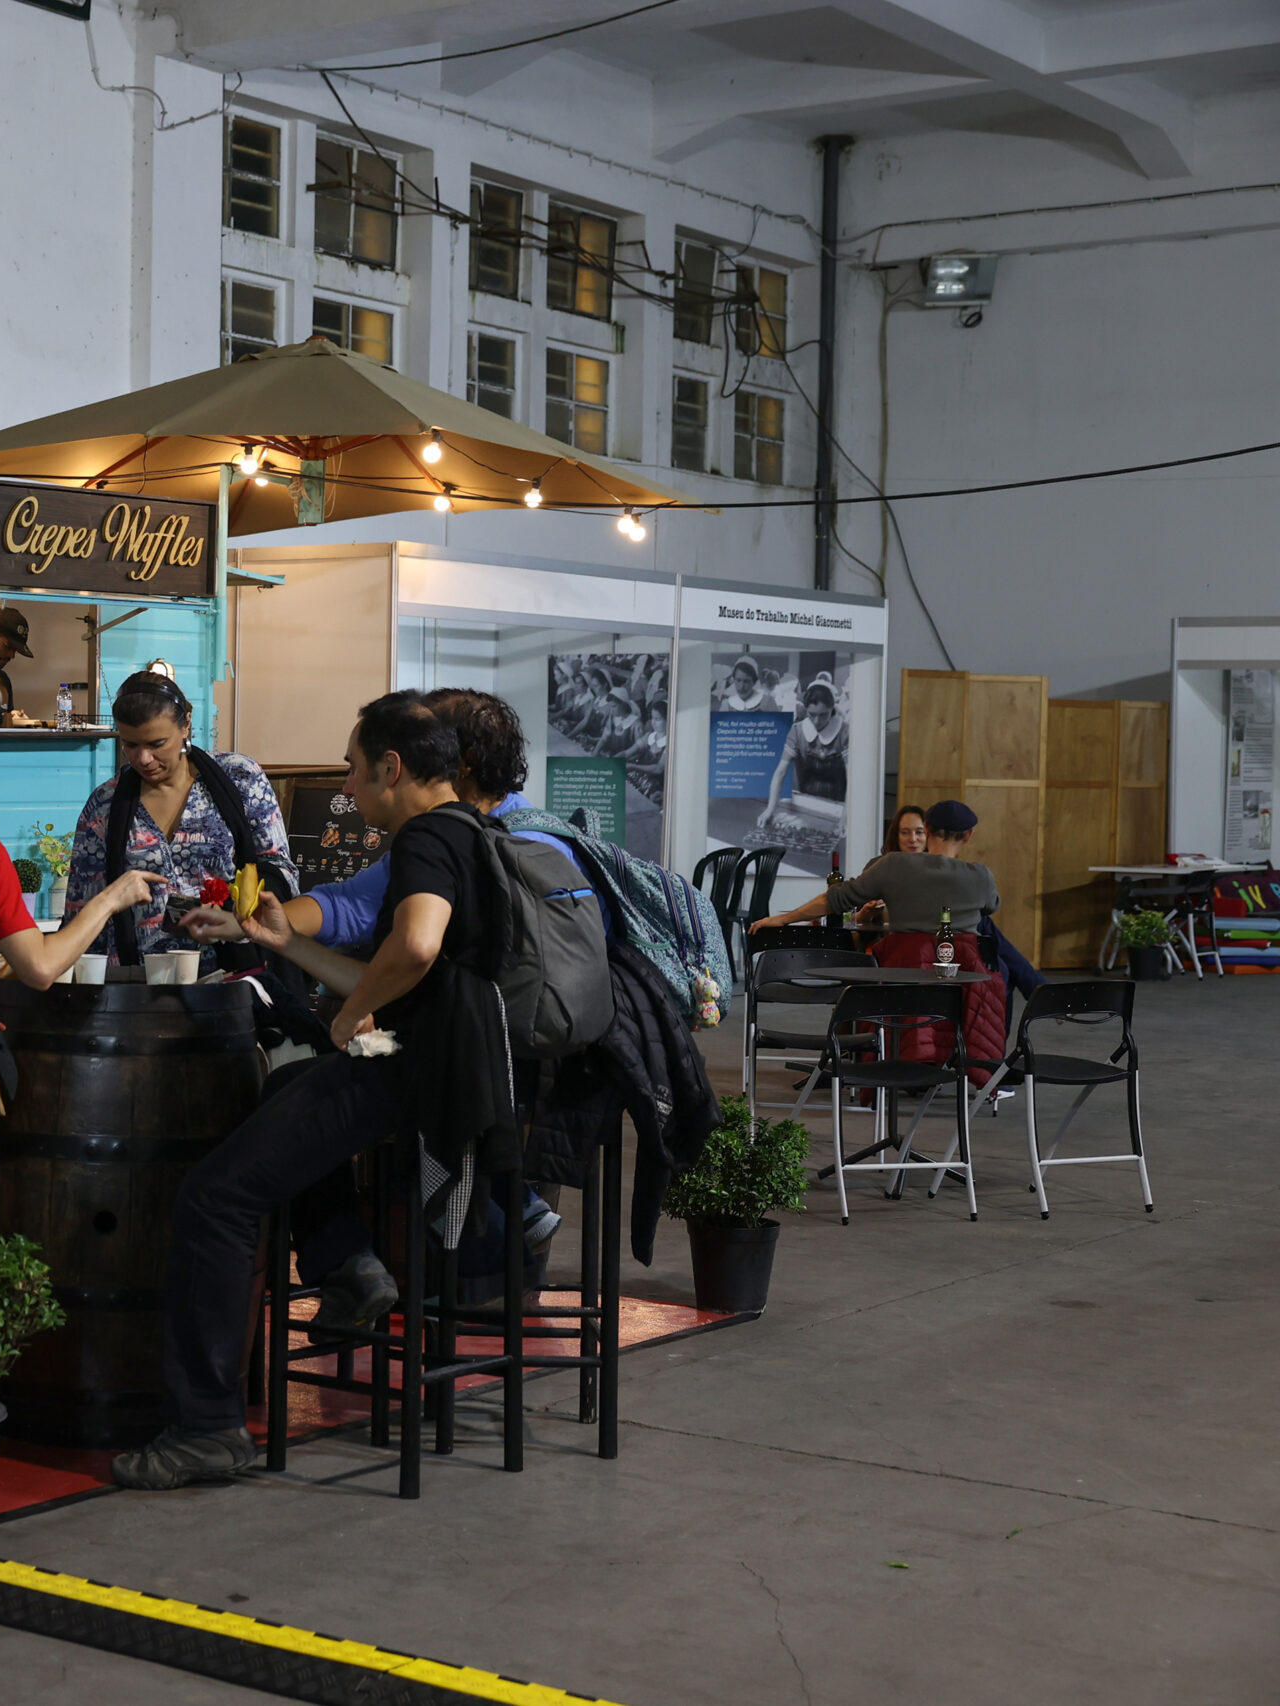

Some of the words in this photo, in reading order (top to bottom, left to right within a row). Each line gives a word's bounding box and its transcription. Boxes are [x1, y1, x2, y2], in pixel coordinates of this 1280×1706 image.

[3, 496, 97, 575] Crepes
[102, 503, 205, 581] Waffles
[718, 605, 744, 619] Museu
[745, 608, 755, 620] do
[756, 609, 789, 624] Trabalho
[790, 612, 814, 626] Michel
[815, 615, 852, 629] Giacometti
